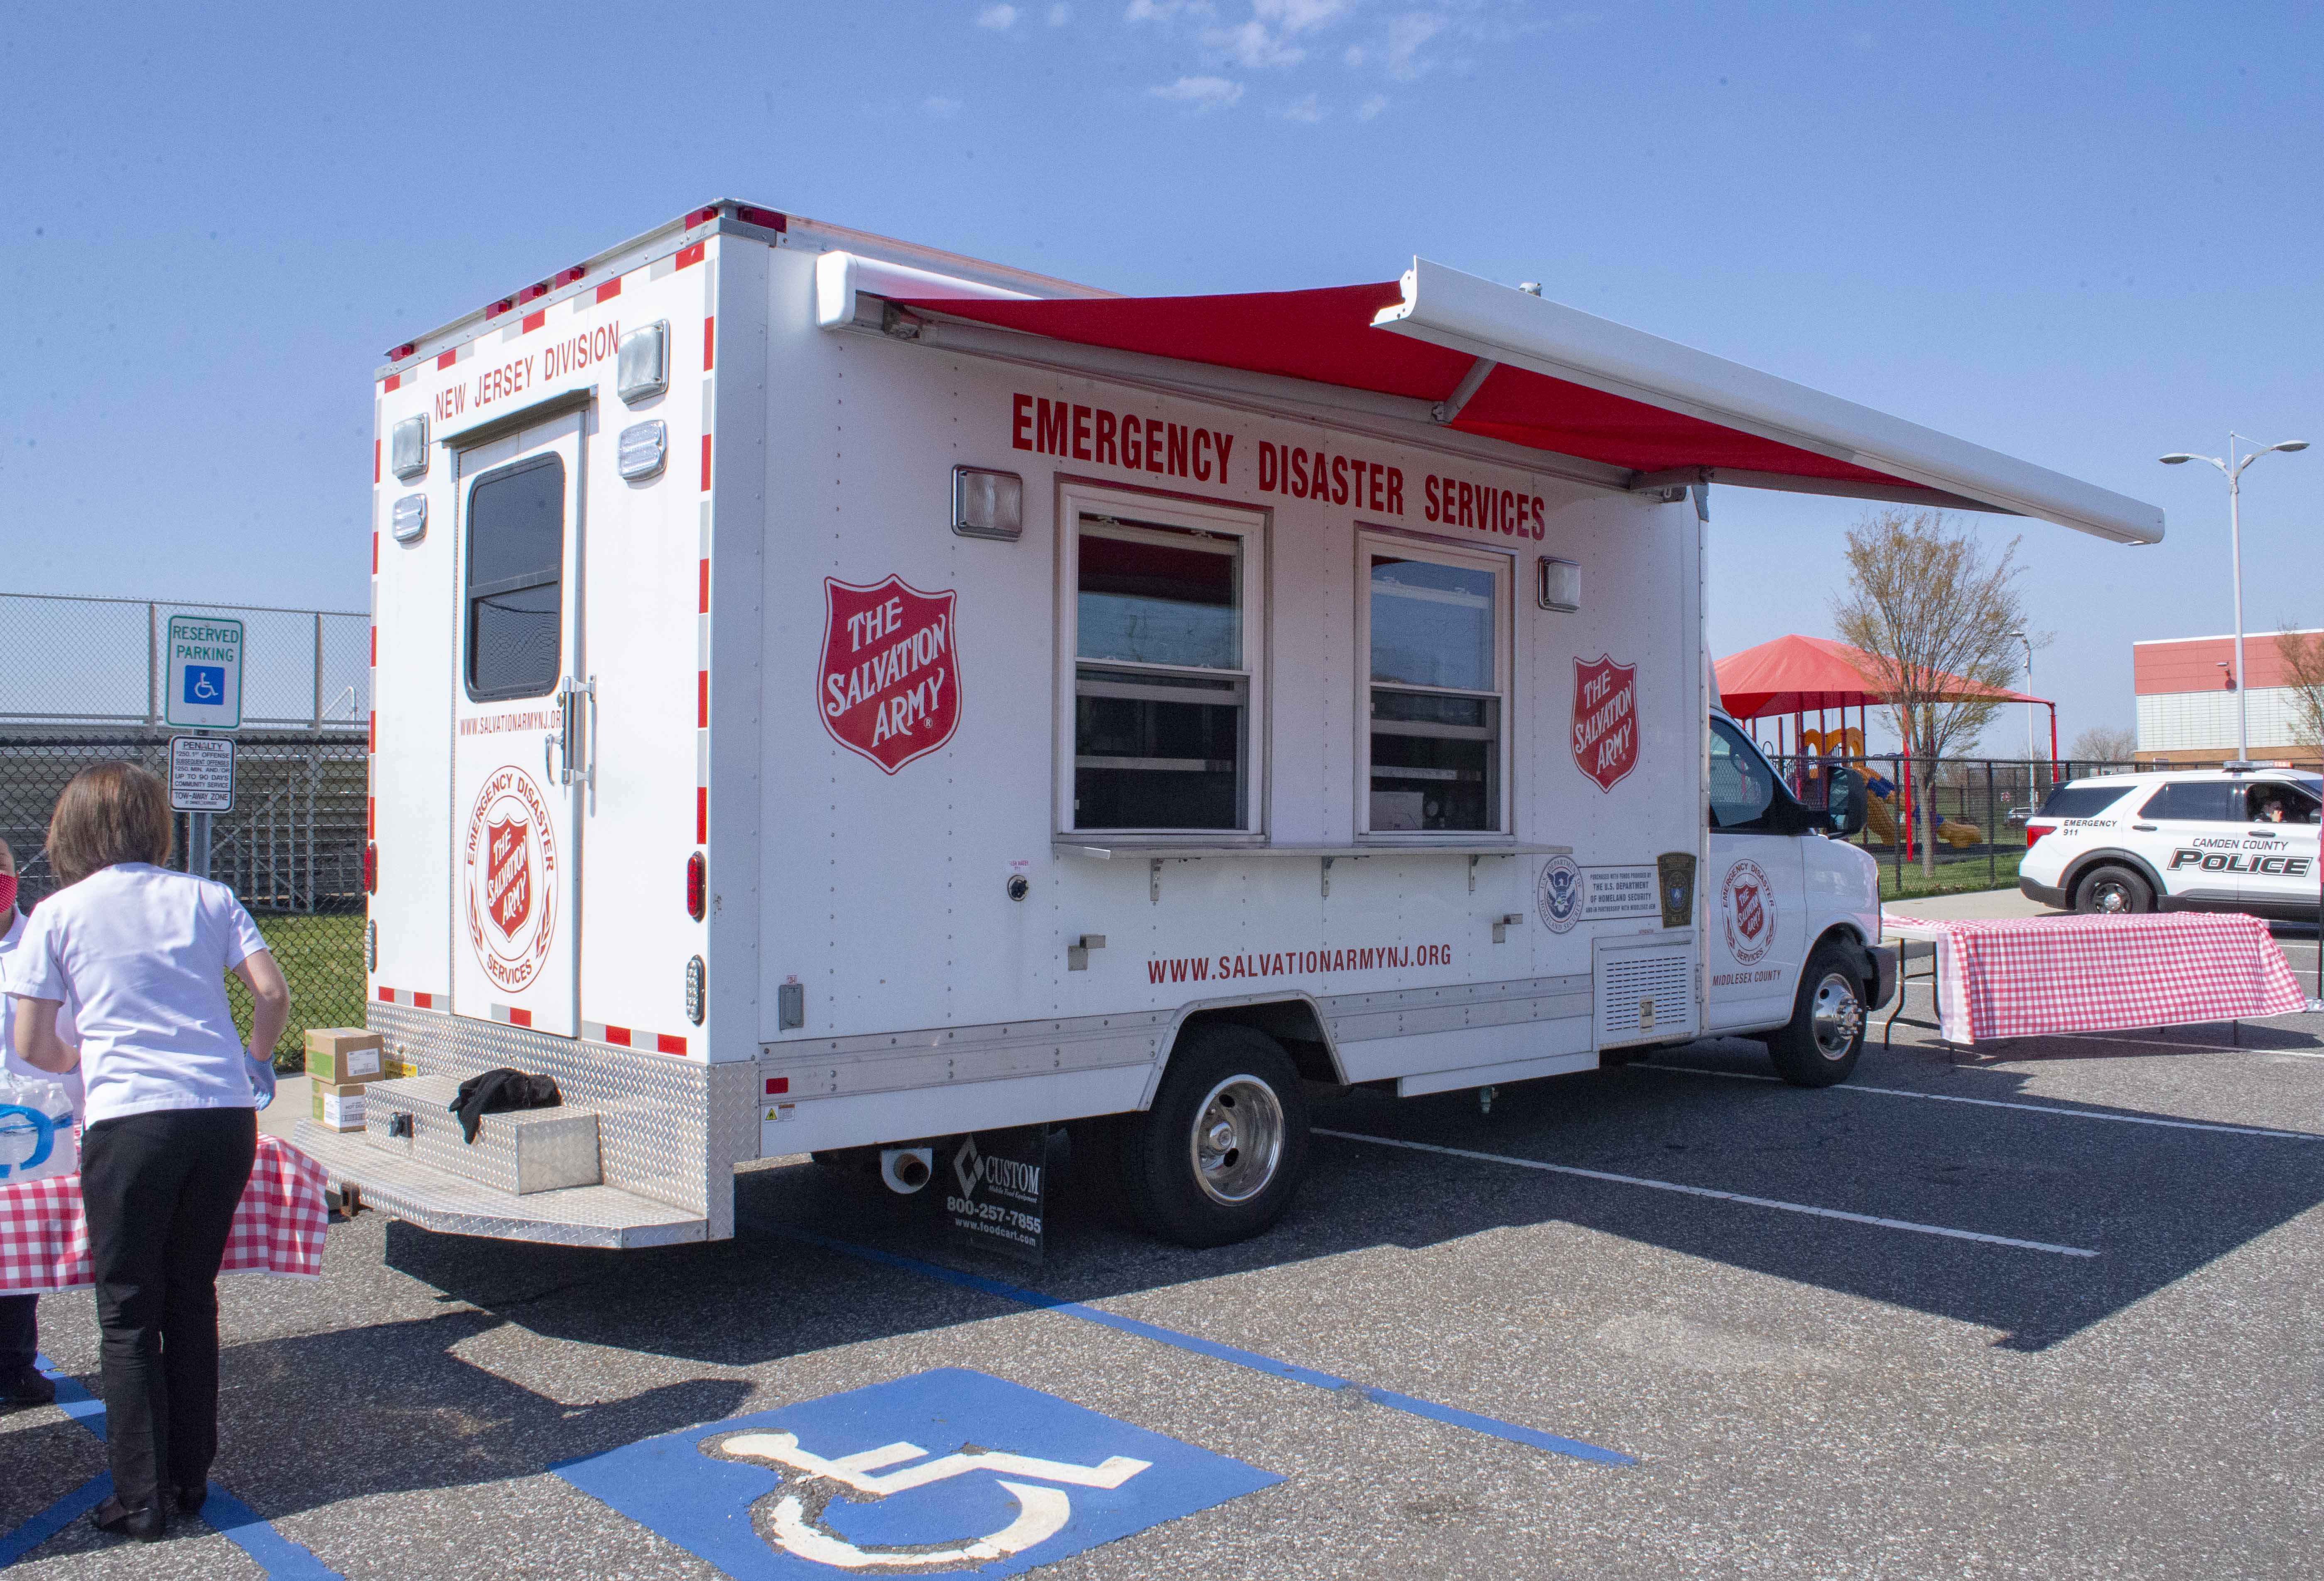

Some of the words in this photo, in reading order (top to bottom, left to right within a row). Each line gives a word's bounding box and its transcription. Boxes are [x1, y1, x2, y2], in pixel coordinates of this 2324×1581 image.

[436, 383, 466, 422] NEW
[475, 355, 534, 408] JERSEY
[545, 321, 618, 381] DIVISION
[1013, 393, 1234, 484] EMERGENCY
[1259, 440, 1404, 515] DISASTER
[1425, 474, 1545, 540] SERVICES
[172, 626, 238, 643] RESERVED
[847, 597, 903, 652] THE
[176, 645, 233, 662] PARKING
[827, 614, 946, 717] SALVATION
[871, 668, 944, 748] ARMY
[1585, 669, 1610, 709] THE
[1575, 680, 1632, 754] SALVATION
[1597, 718, 1632, 774] ARMY
[468, 773, 513, 866] EMERGENCY
[517, 775, 554, 872] DISASTER
[493, 827, 511, 866] THE
[2167, 848, 2313, 877] POLICE
[2193, 838, 2240, 848] CAMDEN
[2243, 840, 2289, 850] COUNTY
[488, 835, 526, 907] SALVATION
[1616, 881, 1649, 890] DEPARTMENT
[1723, 863, 1748, 908] EMERGENCY
[1751, 864, 1774, 907] DISASTER
[502, 871, 526, 926] ARMY
[1599, 894, 1626, 902] HOMELAND
[1628, 893, 1651, 901] SECURITY
[487, 953, 532, 984] SERVICES
[1148, 944, 1451, 984] WWW.SALVATIONARMYNJ.ORG
[1737, 948, 1763, 962] SERVICES
[1713, 972, 1752, 986] MIDDLESEX
[1755, 970, 1781, 982] COUNTY
[986, 1156, 1040, 1195] CUSTOM
[947, 1196, 1041, 1234] 800-257-7855
[955, 1218, 1036, 1246] www.foodcart.com
